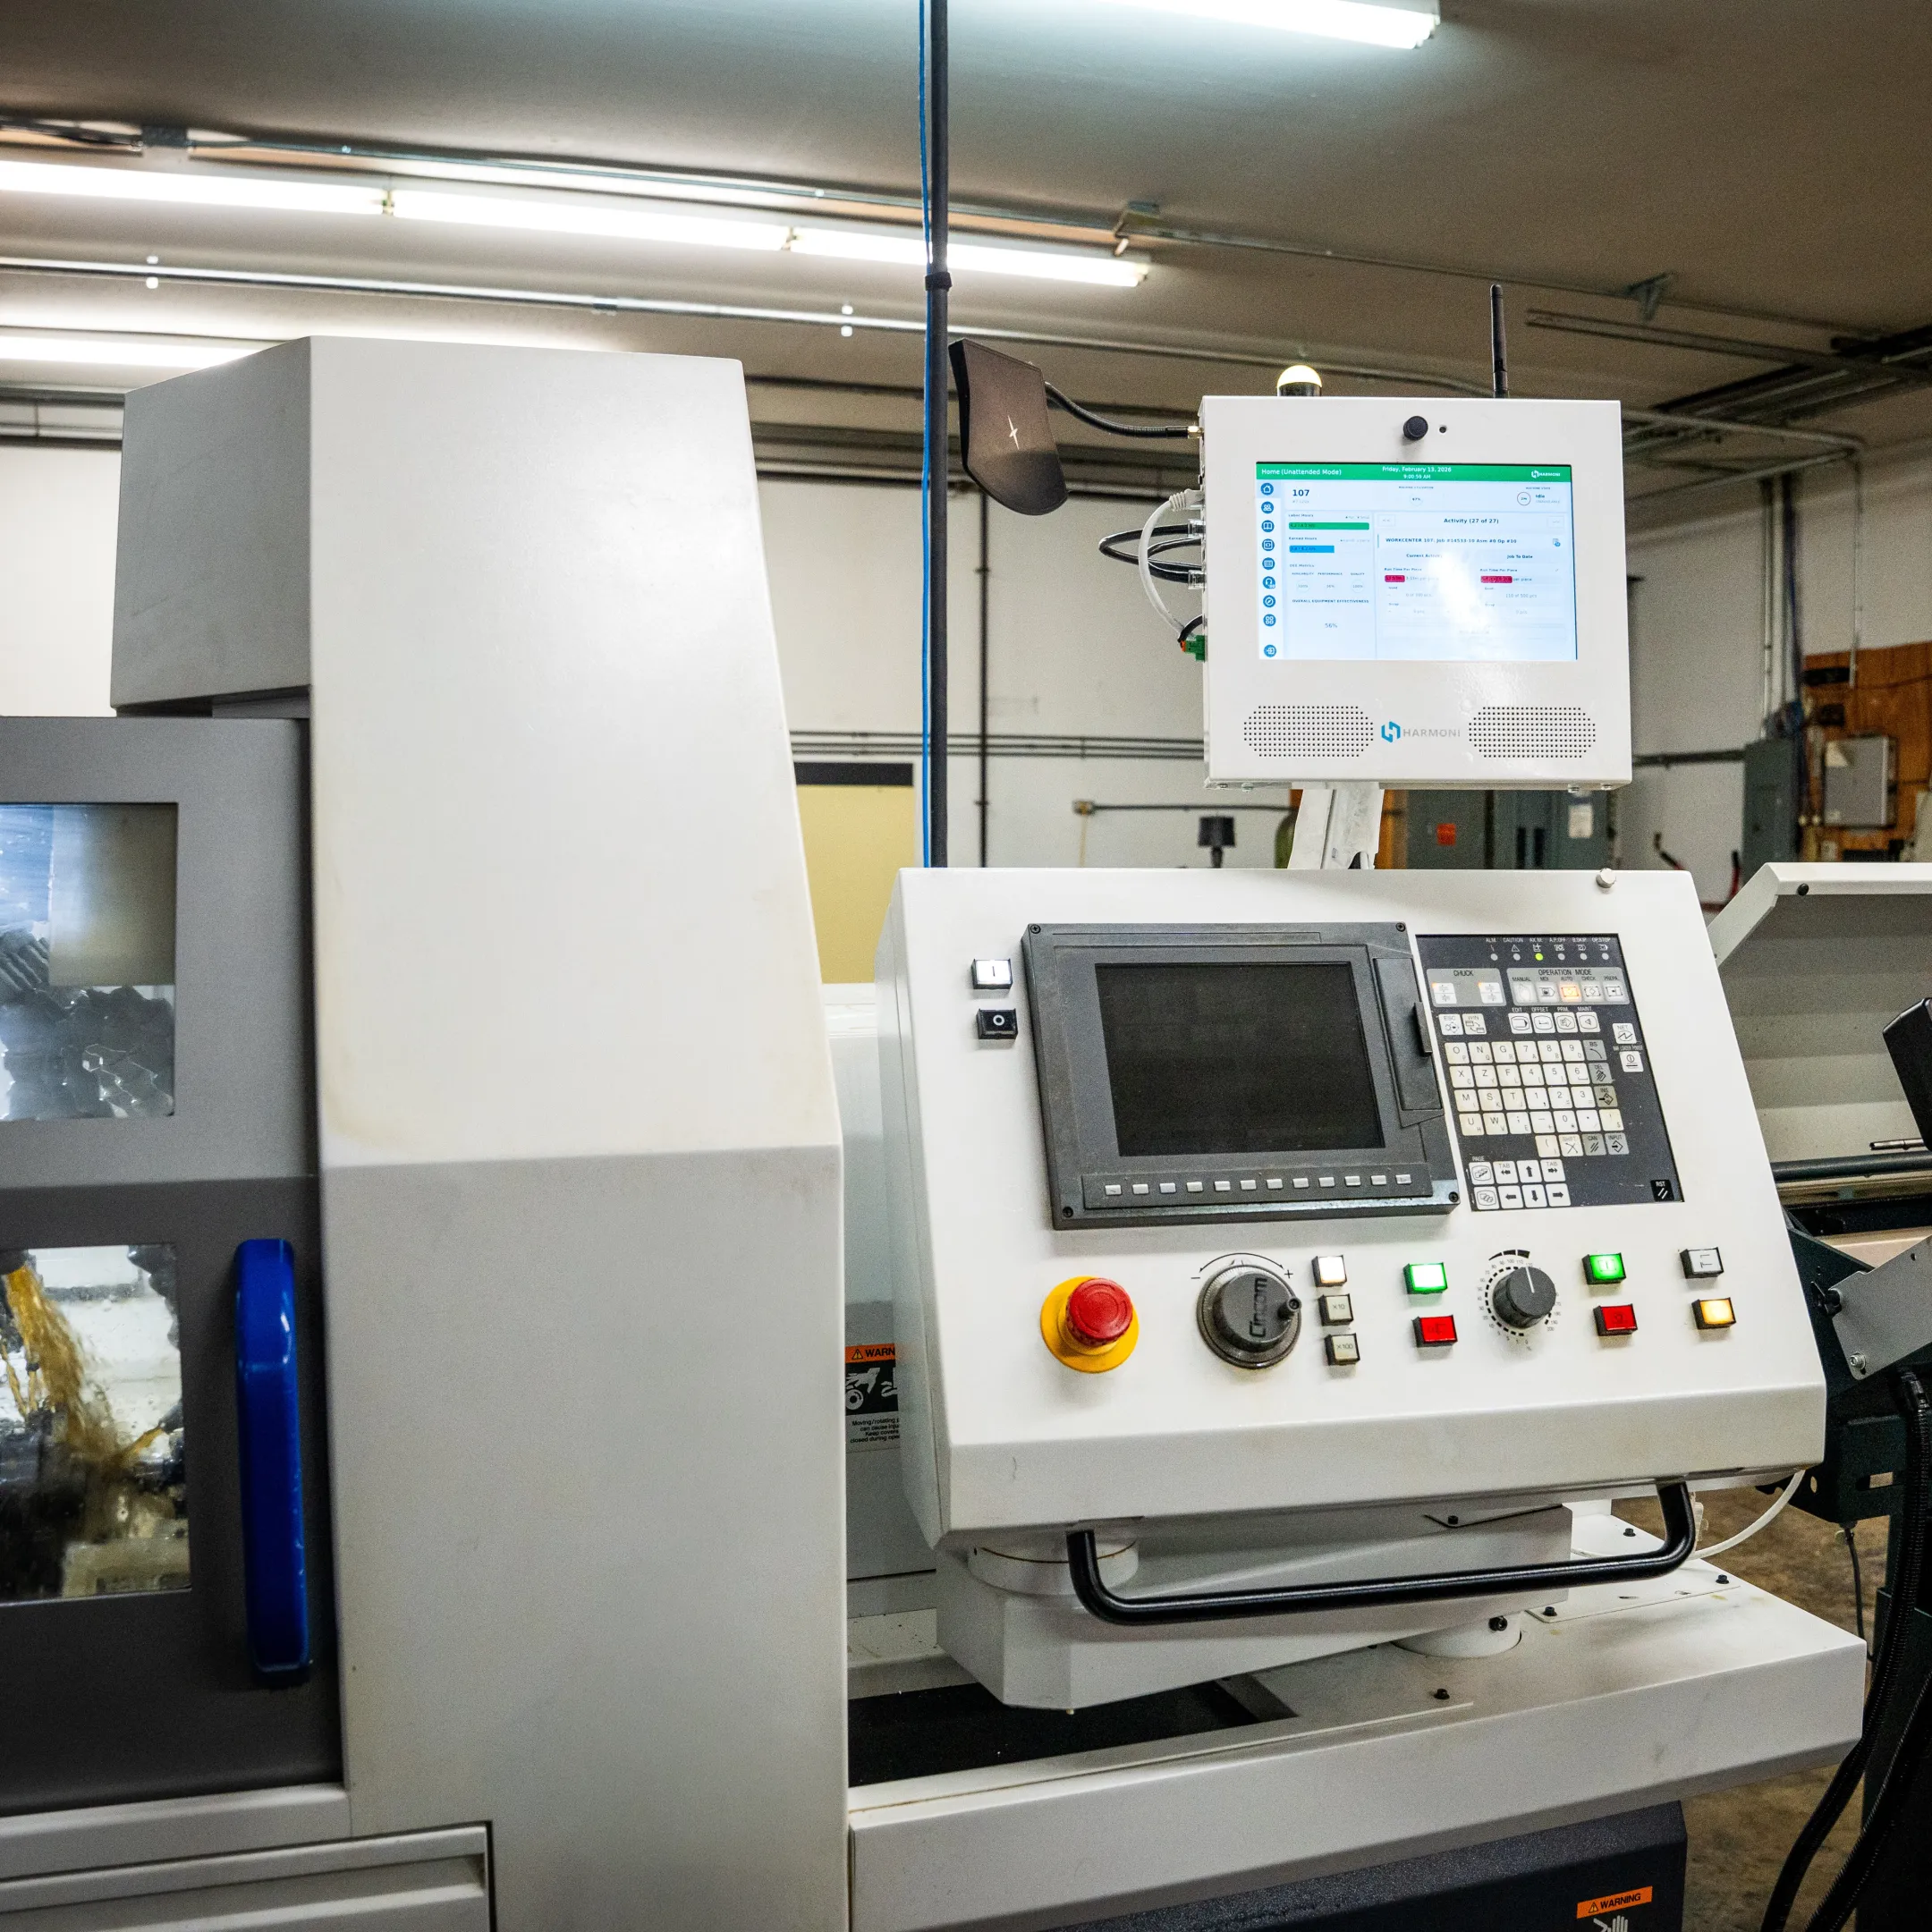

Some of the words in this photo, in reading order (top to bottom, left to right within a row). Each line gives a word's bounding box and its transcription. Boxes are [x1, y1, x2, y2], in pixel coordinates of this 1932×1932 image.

[1403, 728, 1461, 738] HARMONI
[1476, 1046, 1484, 1054] N
[1499, 1045, 1506, 1054] G
[1522, 1045, 1529, 1053] 7
[1546, 1045, 1553, 1053] 8
[1458, 1070, 1465, 1078] X
[1482, 1069, 1488, 1077] Z
[1575, 1067, 1580, 1075] 6
[1462, 1093, 1470, 1101] M
[1487, 1092, 1494, 1101] S
[1510, 1092, 1516, 1100] T
[1467, 1117, 1475, 1126] U
[1250, 1277, 1267, 1337] Cincom
[1600, 1893, 1641, 1910] WARNING
